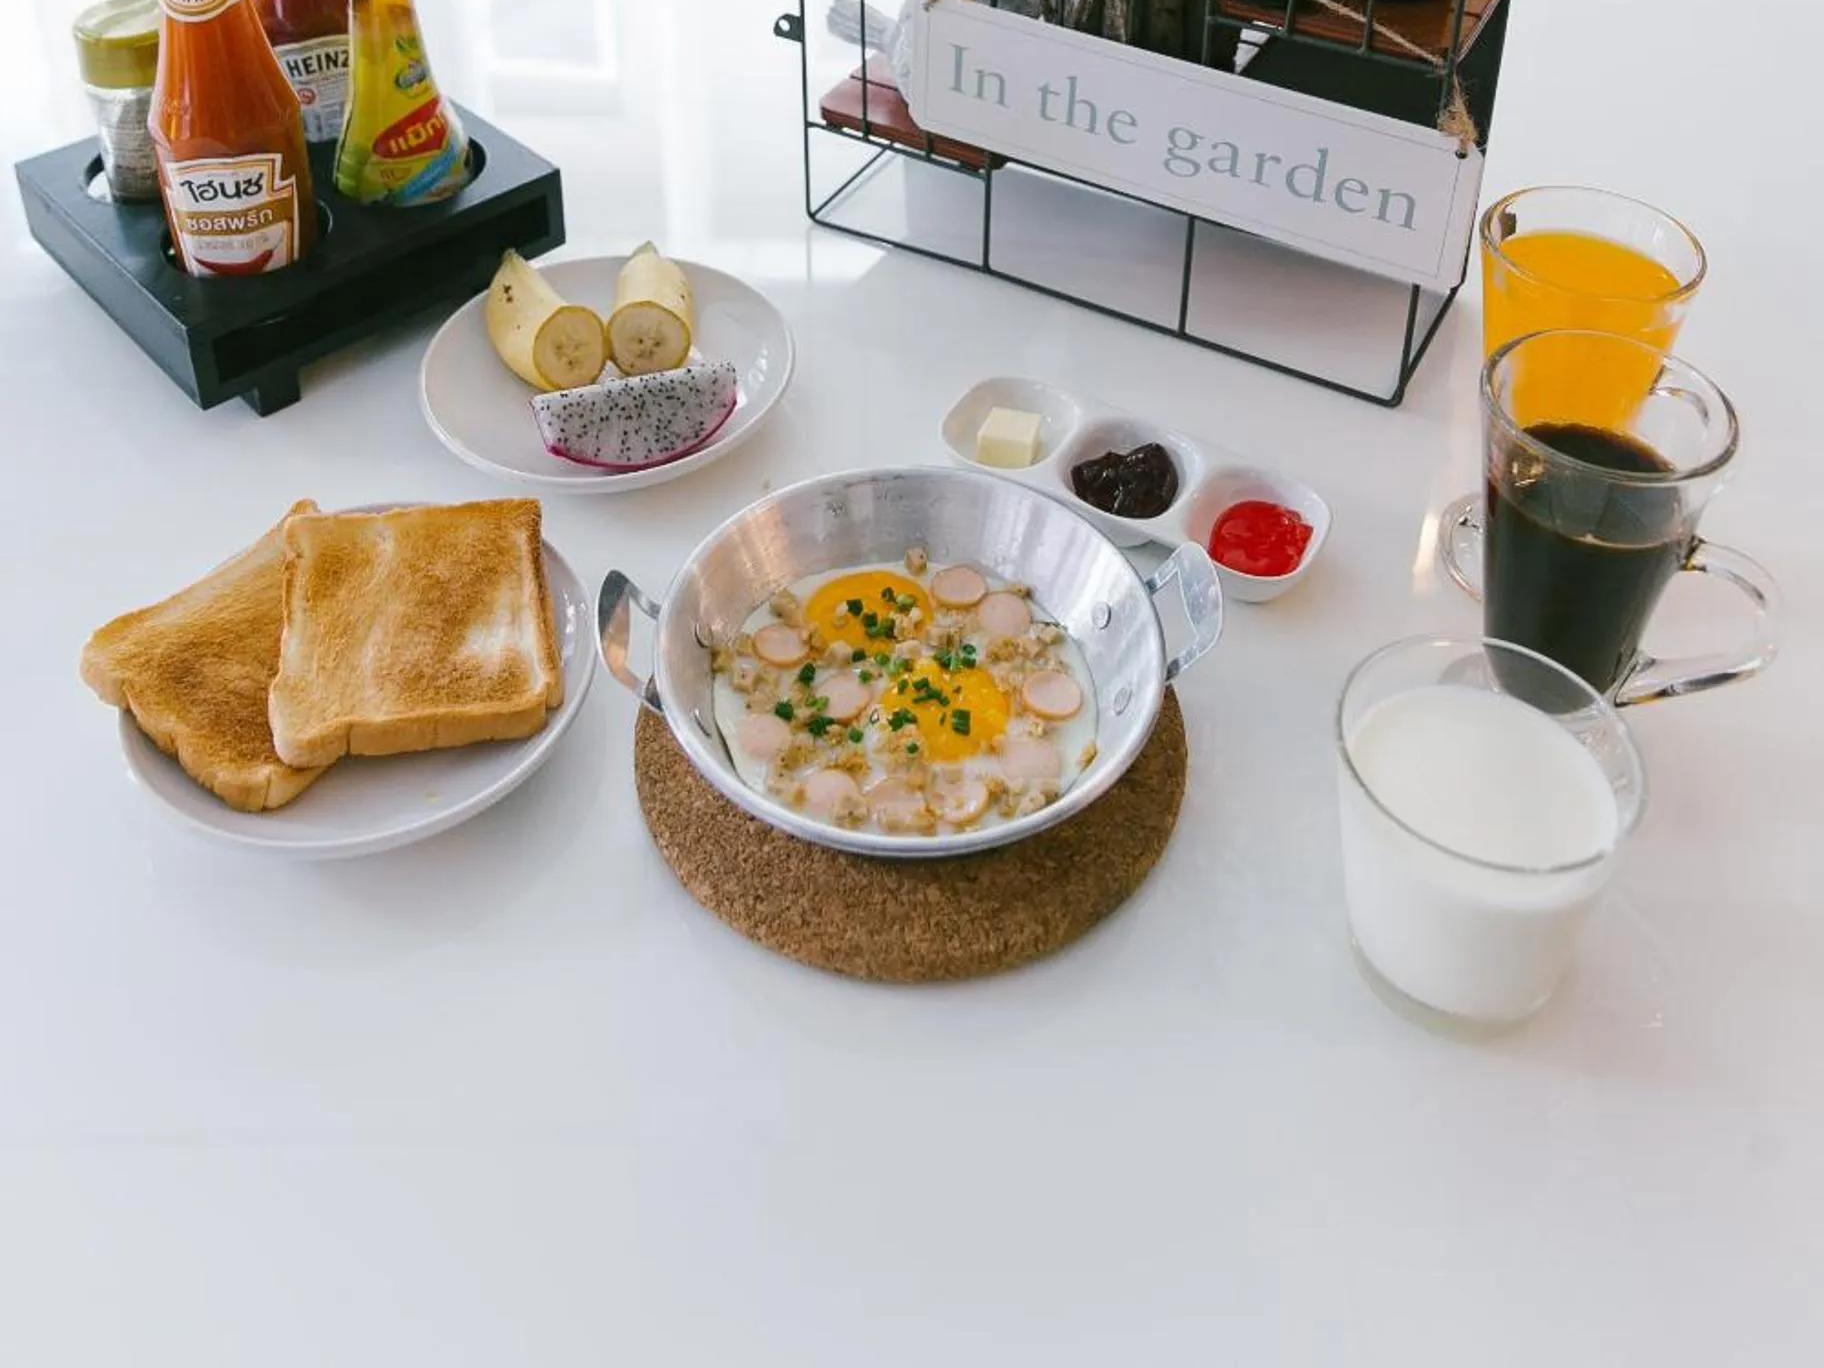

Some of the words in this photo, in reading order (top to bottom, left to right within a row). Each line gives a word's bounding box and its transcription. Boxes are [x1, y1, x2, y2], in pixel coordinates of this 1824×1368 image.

[947, 42, 1009, 109] In
[1037, 75, 1138, 145] the
[1162, 126, 1419, 232] garden
